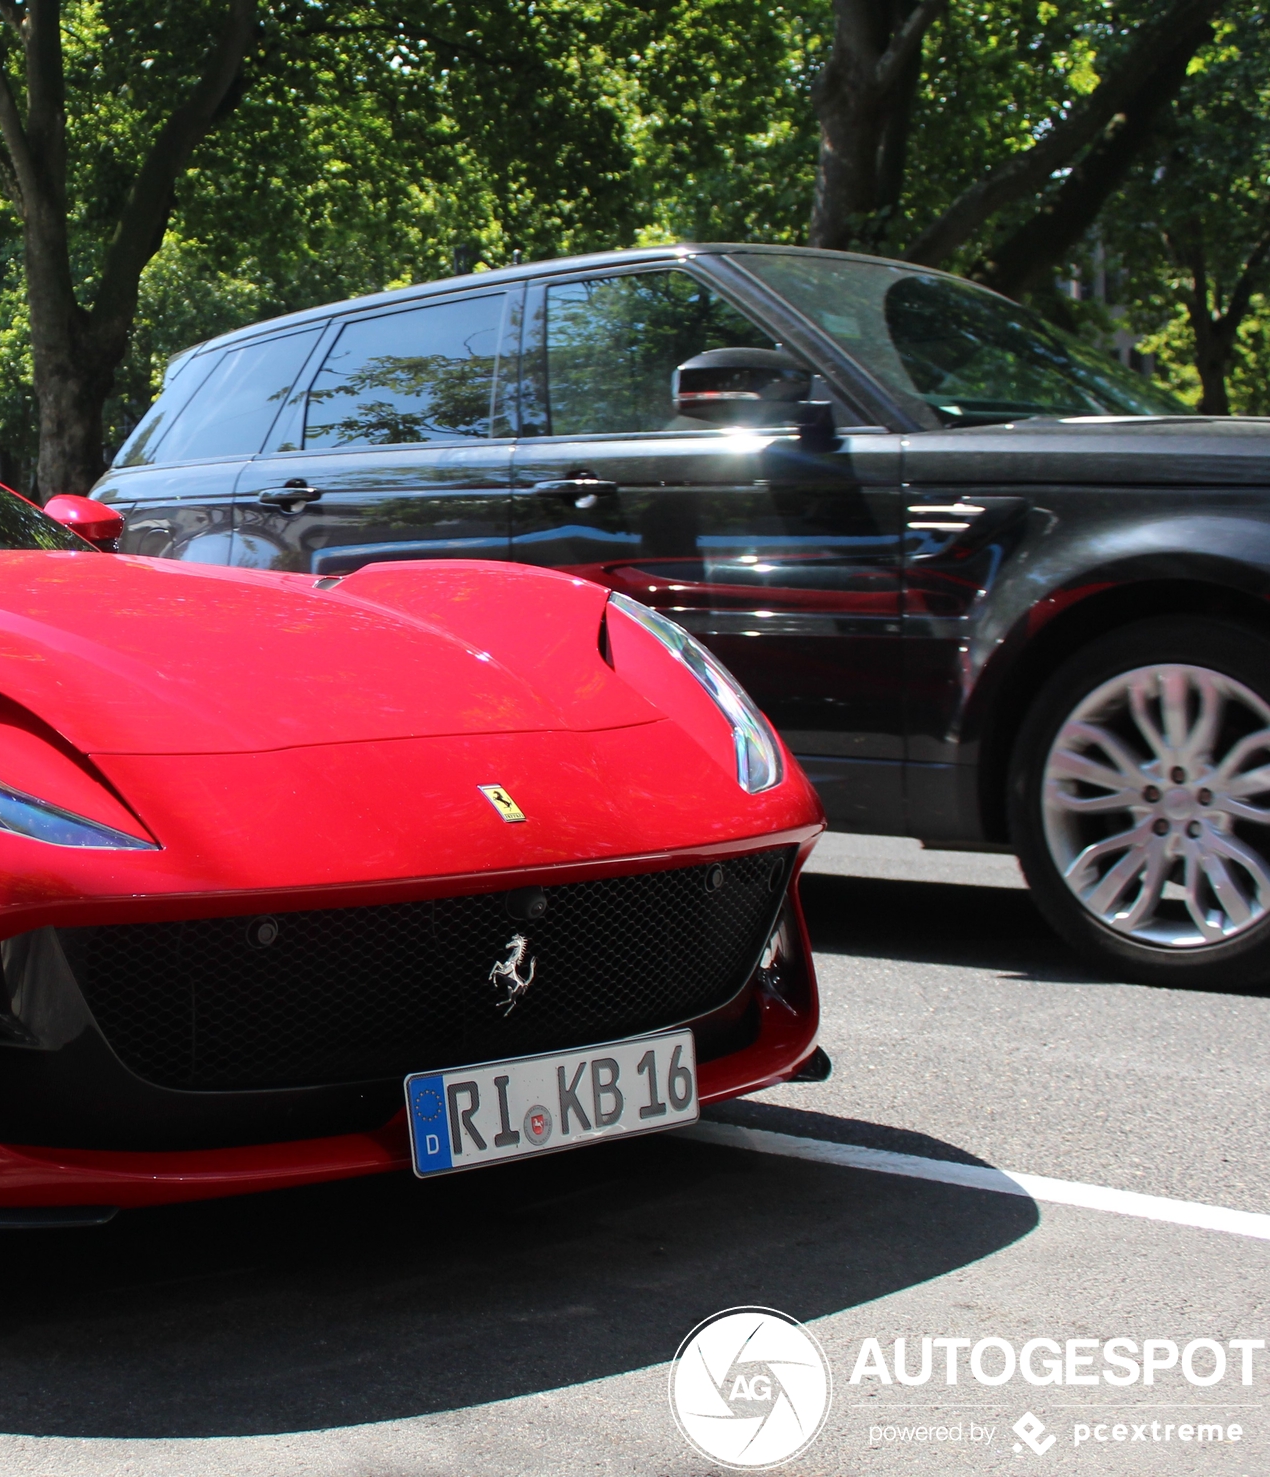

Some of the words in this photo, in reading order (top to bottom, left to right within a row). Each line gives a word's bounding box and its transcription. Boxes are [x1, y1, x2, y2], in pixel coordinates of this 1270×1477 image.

[426, 1134, 440, 1155] D
[447, 1075, 521, 1155] RI
[558, 1057, 625, 1135] KB
[637, 1044, 693, 1121] 16
